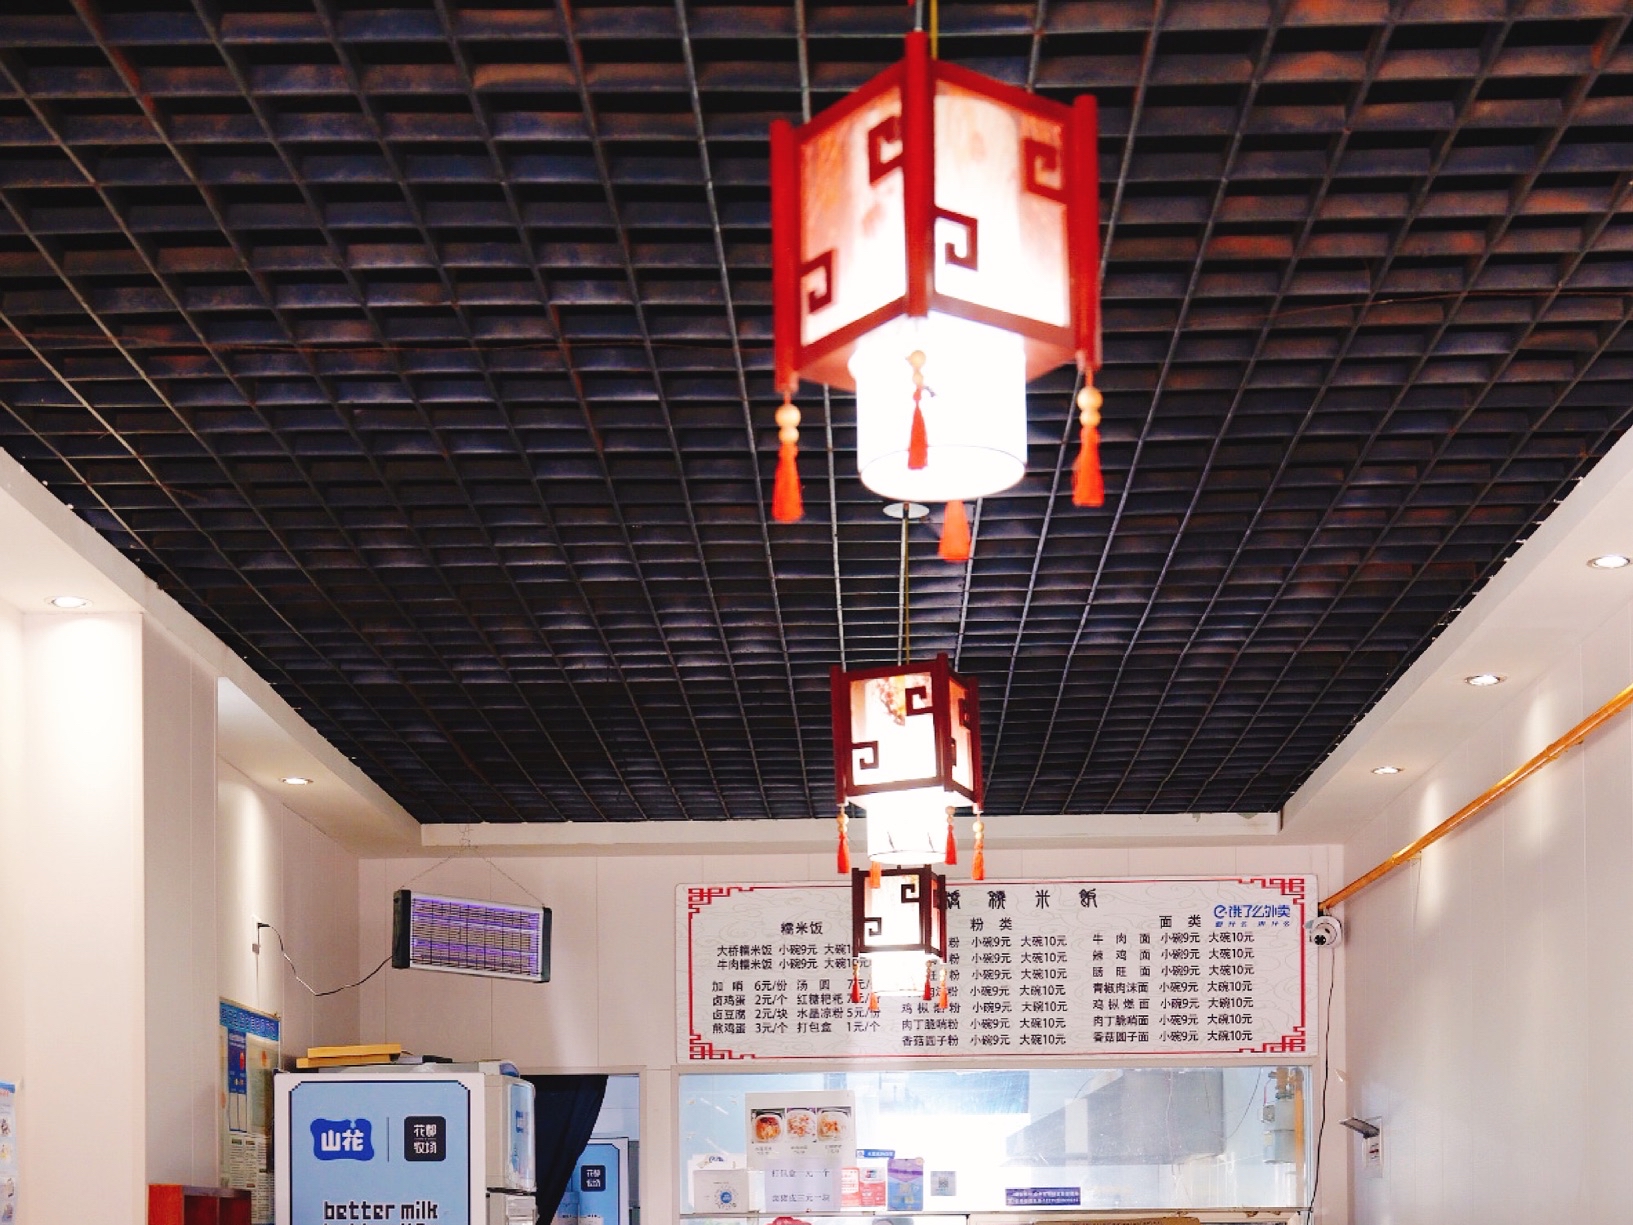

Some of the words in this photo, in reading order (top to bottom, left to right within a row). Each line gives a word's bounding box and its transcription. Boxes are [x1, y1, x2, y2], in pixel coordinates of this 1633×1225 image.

[1229, 905, 1290, 918] 饿了么外卖
[970, 917, 1012, 931] 粉类
[1159, 915, 1201, 927] 面类
[781, 922, 823, 934] 糯米饭
[972, 937, 1011, 947] 小碗9元
[1021, 935, 1067, 947] 大碗10元
[1093, 933, 1150, 944] 牛肉面
[1161, 932, 1200, 944] 小碗9元
[1209, 932, 1254, 942] 大碗10元
[717, 945, 772, 956] 大桥糯米饭
[779, 944, 818, 955] 小碗9元
[824, 944, 851, 956] 大碗1
[1161, 949, 1200, 959] 小碗9元
[1209, 948, 1254, 959] 大碗10元
[972, 953, 1012, 963] 小碗9元
[1021, 952, 1067, 963] 大碗10元
[717, 959, 772, 970] 牛肉糯米饭
[779, 958, 818, 969] 小碗9元
[1161, 965, 1200, 976] 小碗9元
[1209, 964, 1254, 975] 大碗10元
[972, 969, 1012, 980] 小碗9元
[1021, 968, 1067, 979] 大碗10元
[754, 980, 787, 991] 6元/份
[797, 979, 830, 991] 汤圆
[847, 979, 870, 990] 7元/
[970, 986, 1010, 996] 小碗9元
[1020, 985, 1066, 996] 大碗10元
[1159, 982, 1198, 992] 小碗9元
[1208, 981, 1252, 992] 大碗10元
[713, 995, 745, 1006] 卤鸡蛋
[755, 994, 787, 1005] 2元/个
[1161, 998, 1200, 1009] 小碗9元
[1208, 997, 1253, 1009] 大碗10元
[973, 1001, 1012, 1013] 小碗9元
[1022, 1001, 1068, 1012] 大碗10元
[713, 1009, 745, 1020] 卤豆腐
[755, 1008, 788, 1019] 2元/块
[1159, 1014, 1198, 1025] 小碗9元
[1207, 1014, 1252, 1024] 大碗10元
[755, 1022, 788, 1033] 3元/个
[797, 1022, 831, 1033] 打包盒
[847, 1021, 880, 1032] 1元/个
[970, 1018, 1010, 1029] 小碗9元
[1020, 1018, 1066, 1028] 大碗10元
[903, 1035, 958, 1046] 香菇圆子粉
[971, 1034, 1010, 1046] 小碗9元
[1020, 1034, 1066, 1045] 大碗10元
[1093, 1032, 1148, 1042] 香菇圆子面
[1159, 1031, 1198, 1042] 小碗9元
[1207, 1030, 1253, 1041] 大碗10元
[413, 1124, 437, 1137] 花都
[321, 1129, 364, 1152] 山花
[413, 1141, 437, 1154] 牧场
[324, 1200, 395, 1220] better
[401, 1200, 438, 1220] milk
